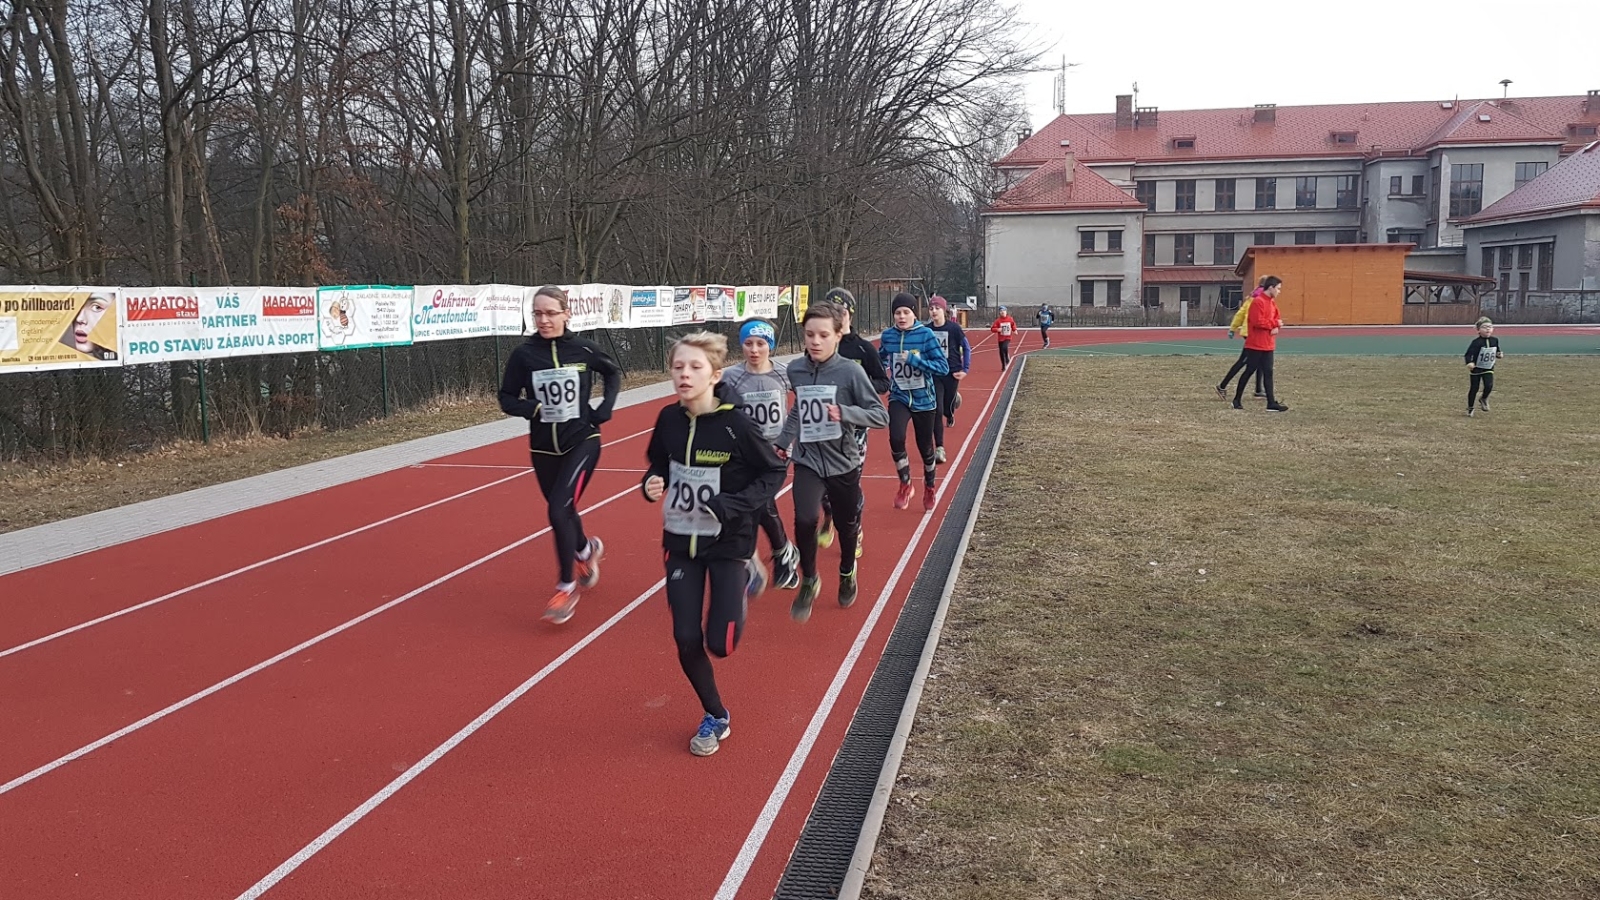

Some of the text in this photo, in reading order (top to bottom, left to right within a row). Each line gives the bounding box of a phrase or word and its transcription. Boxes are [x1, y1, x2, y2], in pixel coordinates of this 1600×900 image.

[4, 298, 75, 313] po billboard!
[126, 296, 198, 310] MARATON
[216, 292, 240, 308] VÁŠ
[263, 296, 314, 308] MARATON
[432, 289, 476, 308] Cukrárna
[201, 314, 257, 328] PARTNER
[129, 332, 314, 355] PRO STAVBU ZÁBAVU A SPORT
[1479, 352, 1495, 362] 186
[538, 379, 576, 406] 198
